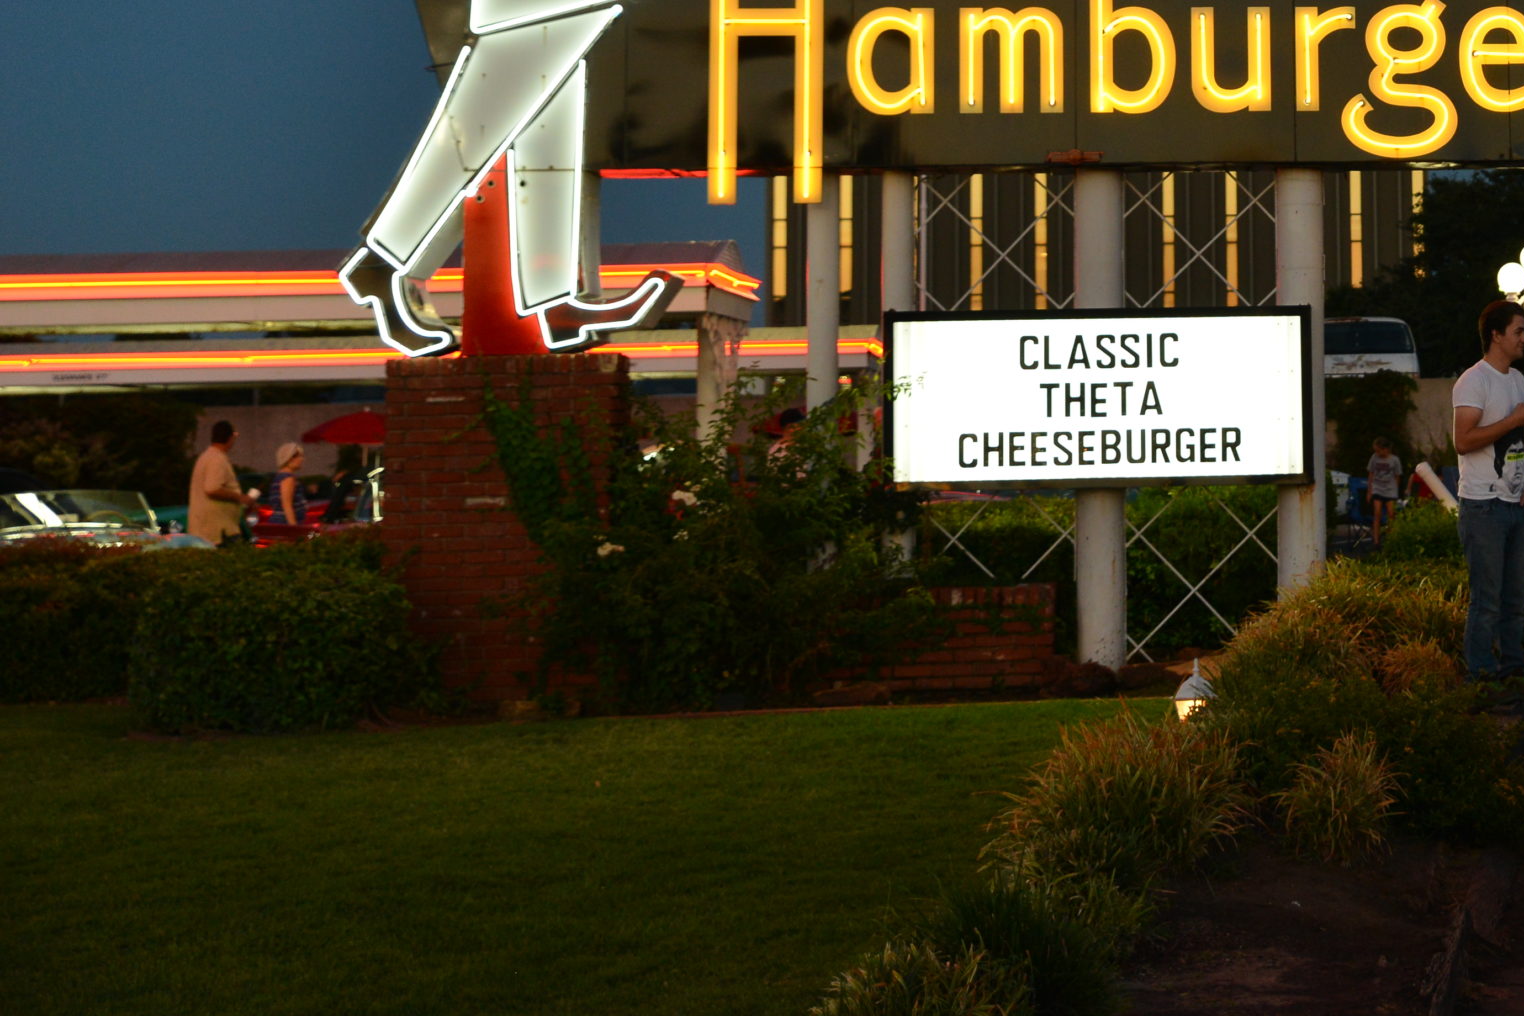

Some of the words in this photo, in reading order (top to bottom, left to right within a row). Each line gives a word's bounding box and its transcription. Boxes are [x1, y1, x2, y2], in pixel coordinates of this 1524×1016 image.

[1019, 333, 1180, 370] CLASSIC
[1040, 381, 1163, 418] THETA
[958, 427, 1241, 469] CHEESEBURGER
